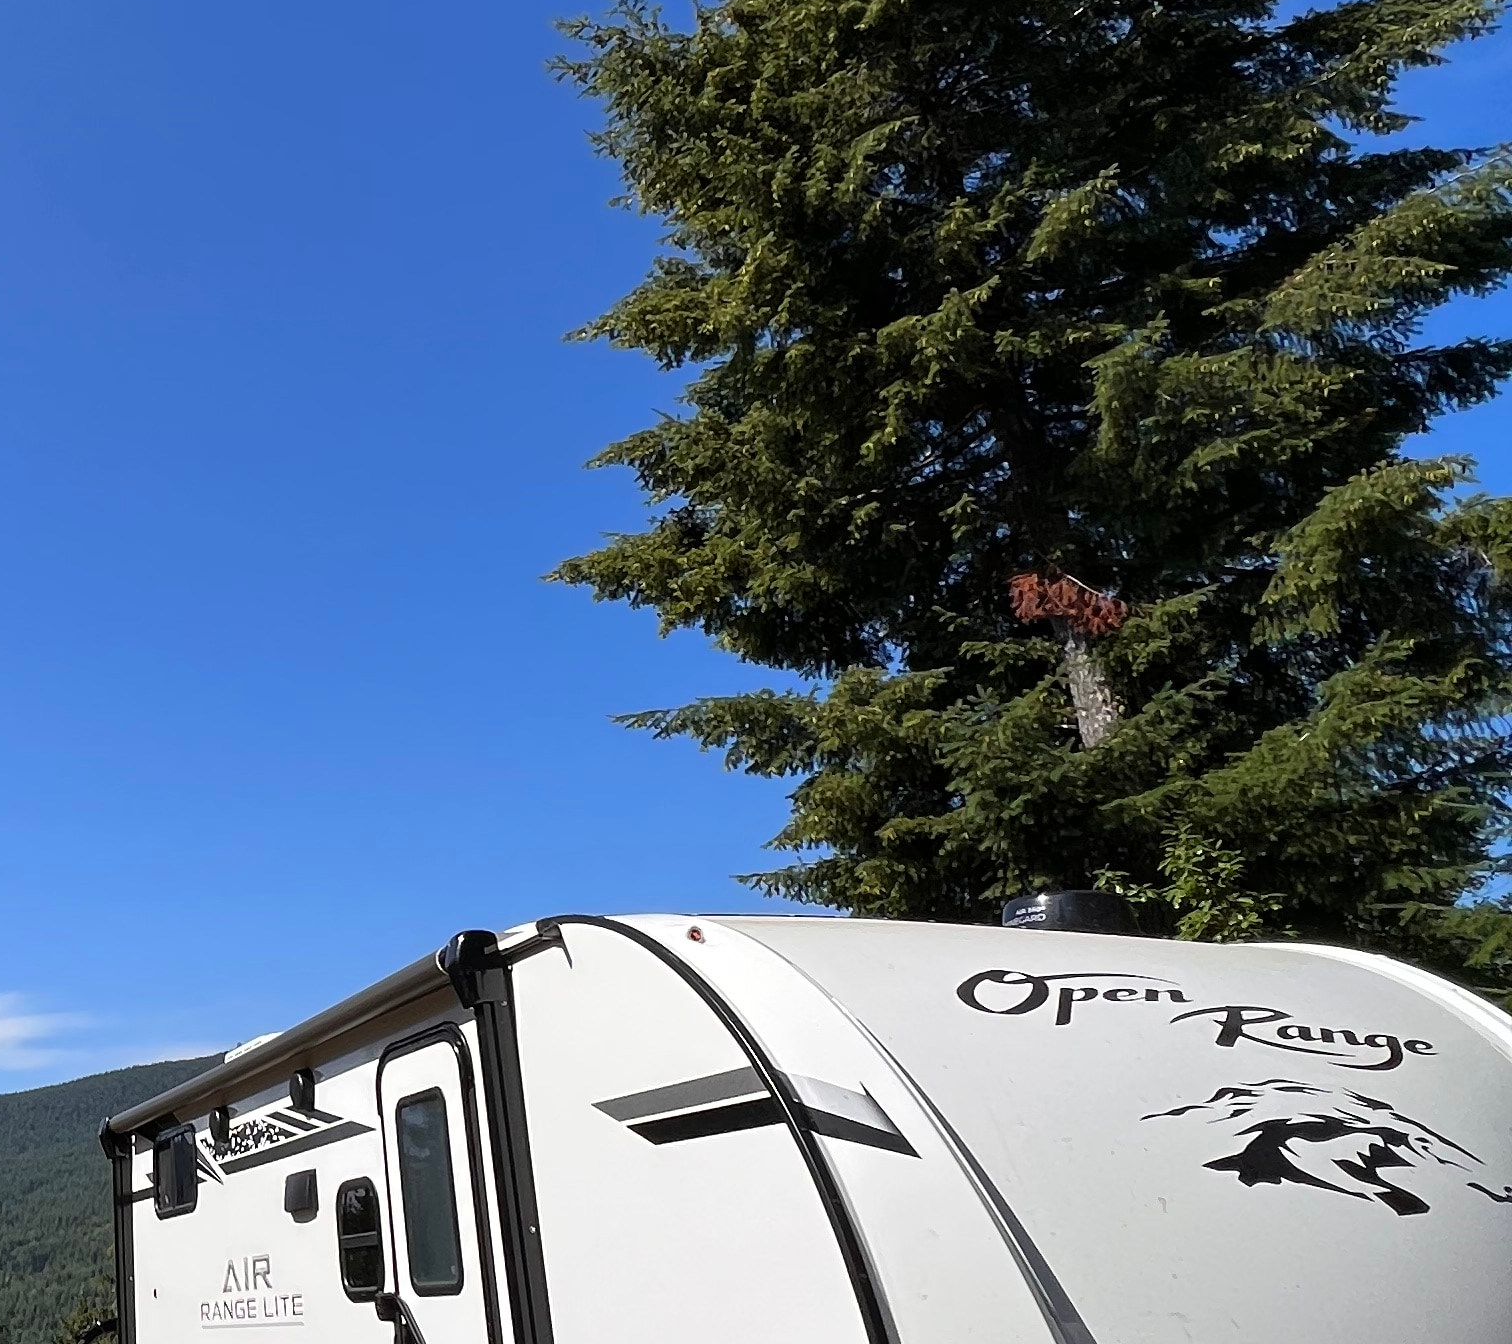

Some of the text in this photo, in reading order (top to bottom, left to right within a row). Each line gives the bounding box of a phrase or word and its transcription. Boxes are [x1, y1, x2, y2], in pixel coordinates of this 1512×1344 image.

[956, 969, 1439, 1071] Open Range
[223, 1254, 272, 1293] AIR
[200, 1294, 304, 1321] RANGE LITE
